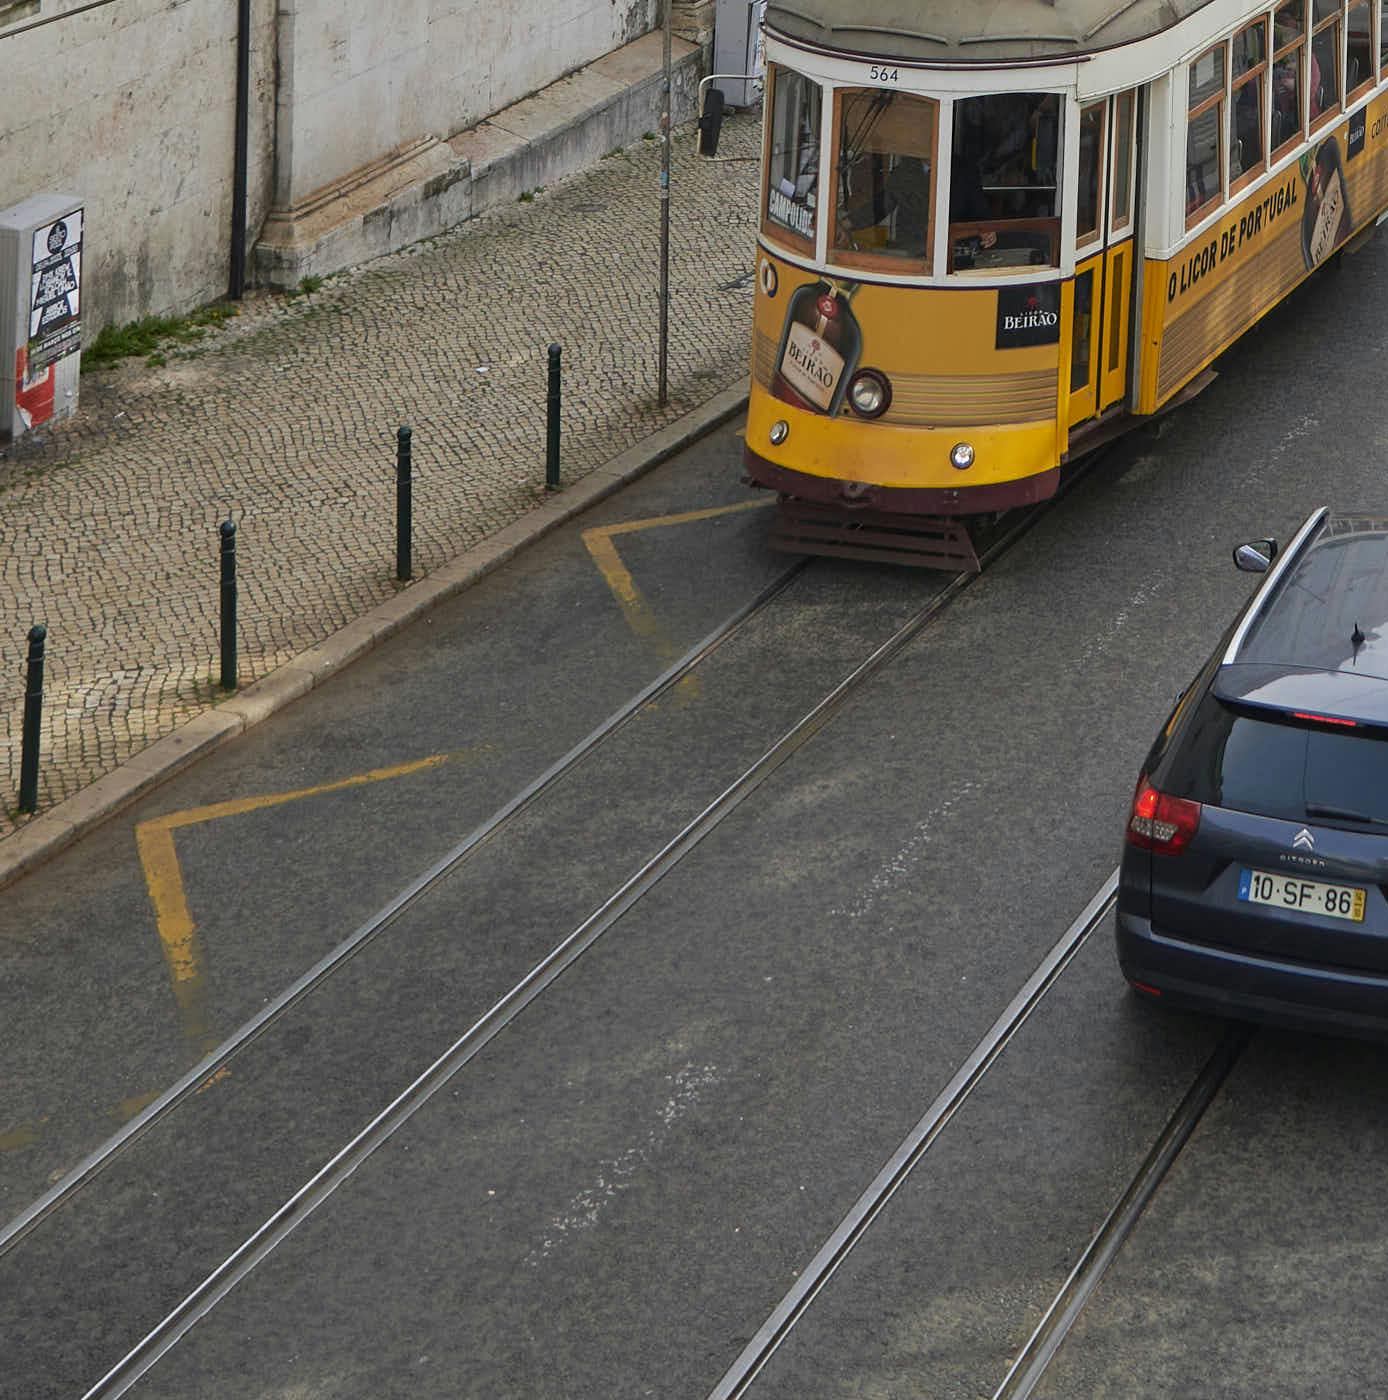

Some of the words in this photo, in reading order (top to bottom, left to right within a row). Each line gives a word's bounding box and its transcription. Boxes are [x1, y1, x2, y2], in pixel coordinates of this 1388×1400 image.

[869, 65, 899, 82] 564
[1168, 271, 1177, 303] O
[1179, 240, 1217, 296] LICOR
[1220, 223, 1237, 263] DE
[1238, 176, 1297, 248] PORTUGAL
[1004, 311, 1058, 330] BEIRÃO
[789, 341, 833, 388] BEIRÃO
